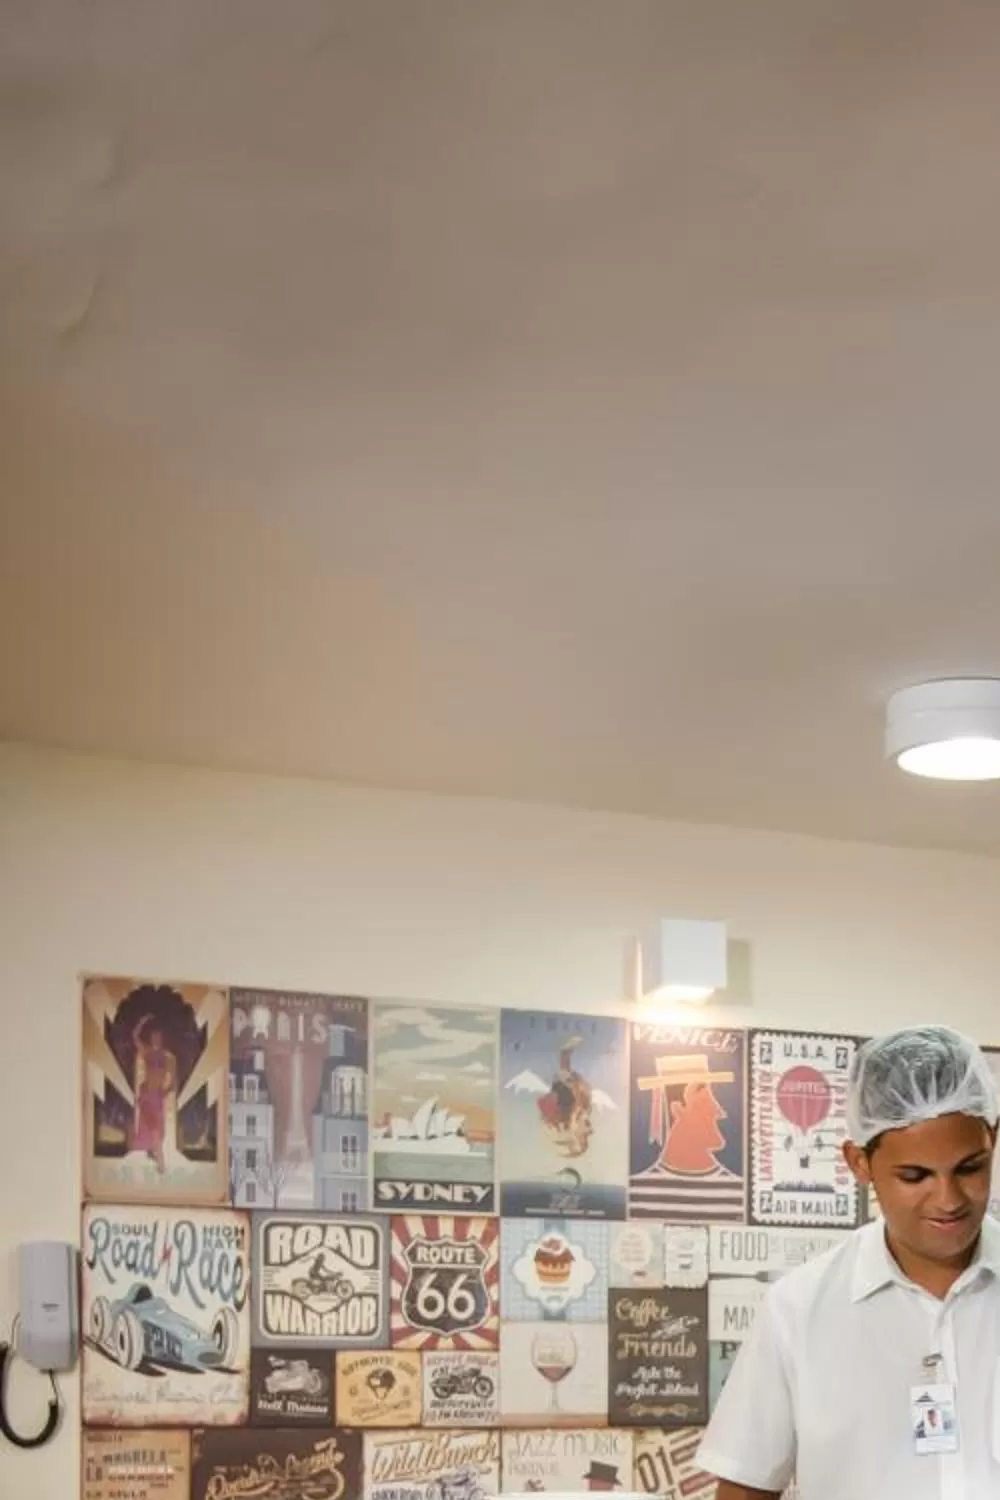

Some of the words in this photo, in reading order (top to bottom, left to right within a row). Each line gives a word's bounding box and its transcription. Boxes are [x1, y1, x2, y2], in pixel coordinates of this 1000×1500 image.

[232, 1006, 328, 1044] PARIS
[632, 1023, 742, 1053] VENICE
[373, 1180, 493, 1206] SYDNEY
[775, 1199, 797, 1215] AIR
[801, 1200, 836, 1217] MAIL
[267, 1225, 376, 1267] ROAD
[416, 1246, 477, 1265] ROUTE
[719, 1231, 769, 1262] FOOD
[86, 1217, 160, 1286] Road
[168, 1219, 249, 1313] Race
[416, 1273, 476, 1321] 66
[264, 1293, 377, 1335] WARRIOR
[616, 1333, 698, 1360] Friends
